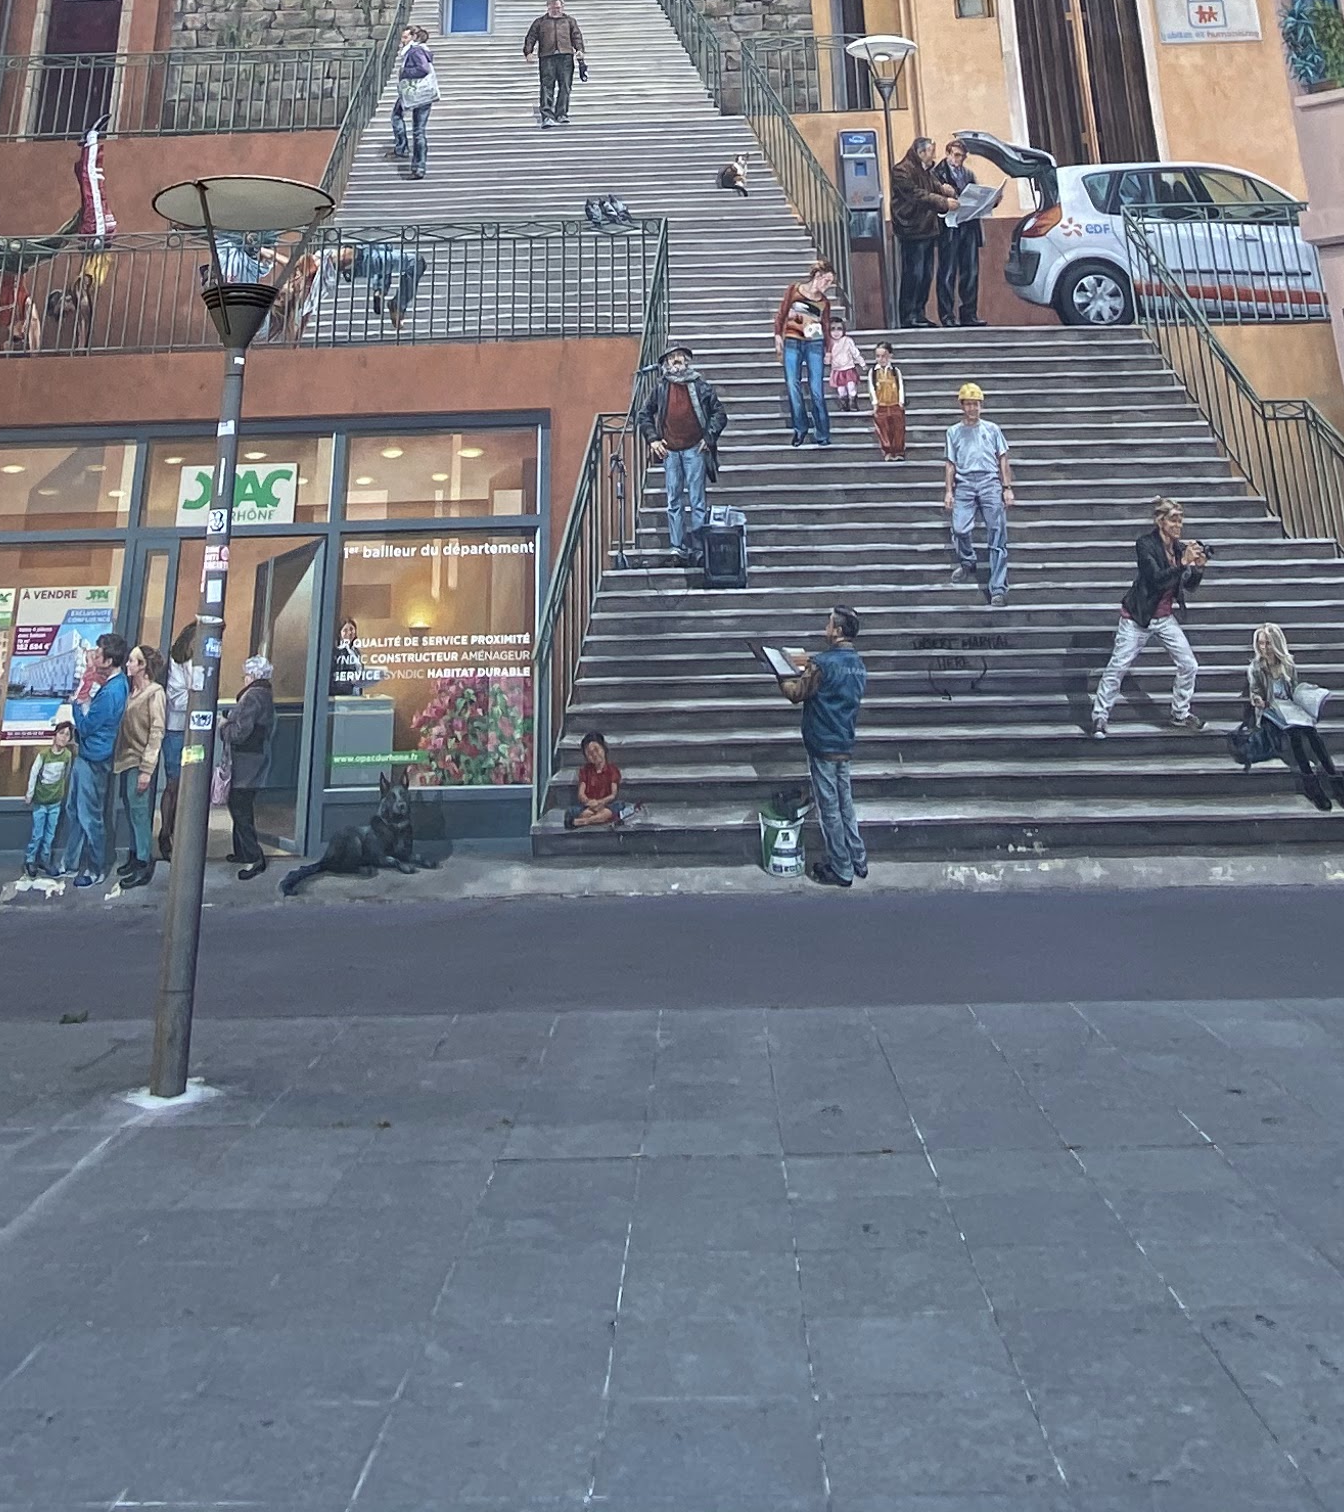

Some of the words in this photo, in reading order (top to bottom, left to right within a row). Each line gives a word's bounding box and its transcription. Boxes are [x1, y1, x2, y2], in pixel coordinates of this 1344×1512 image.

[363, 545, 417, 558] bailleur
[420, 544, 439, 557] du
[443, 541, 535, 558] département
[23, 589, 30, 600] À
[33, 589, 78, 600] VENDRE
[353, 635, 400, 648] QUALITÉ
[403, 636, 417, 646] DE
[422, 635, 468, 647] SERVICE
[471, 631, 531, 645] PROXIMITÉ
[370, 651, 458, 664] CONSTRUCTEUR
[461, 649, 530, 661] AMÉNAGEUR
[384, 668, 424, 680] SYNDIC
[427, 667, 476, 678] HABITAT
[477, 666, 531, 678] DURABLE
